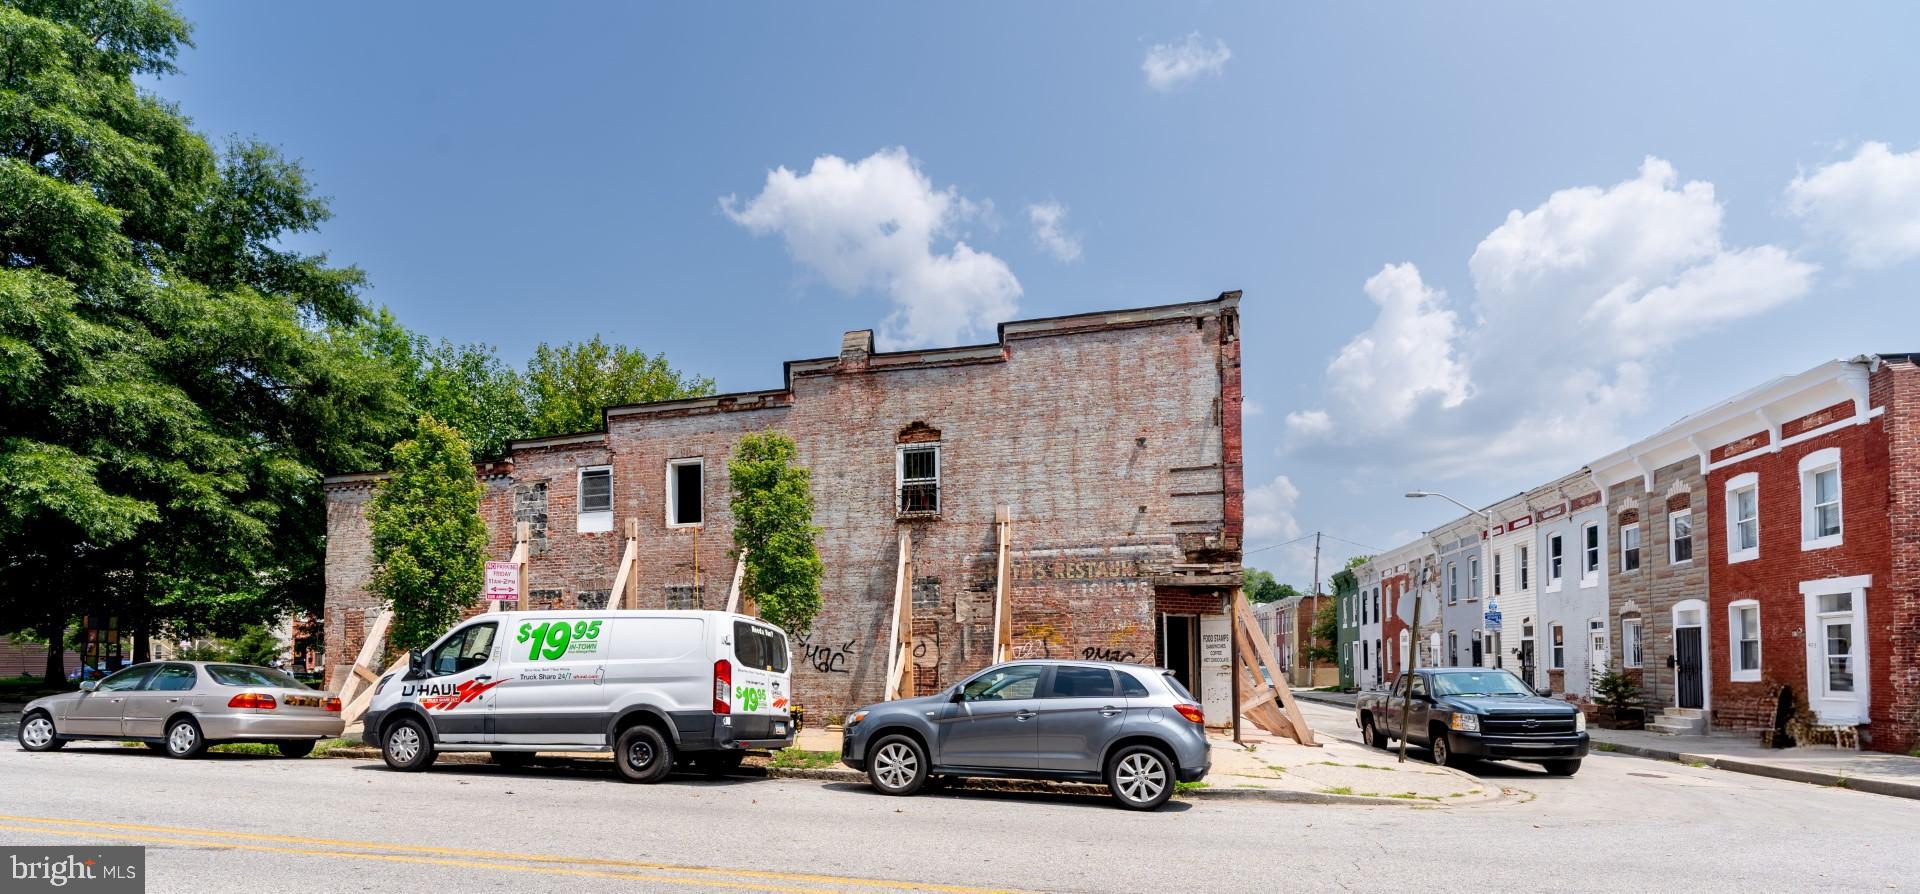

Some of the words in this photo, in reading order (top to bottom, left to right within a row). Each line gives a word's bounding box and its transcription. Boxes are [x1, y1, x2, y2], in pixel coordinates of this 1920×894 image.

[1052, 558, 1152, 580] RESTAUR
[1203, 634, 1214, 643] FOOD
[1214, 634, 1229, 643] STAMPS
[568, 643, 598, 651] IN-TOWN
[557, 672, 572, 681] 24/7
